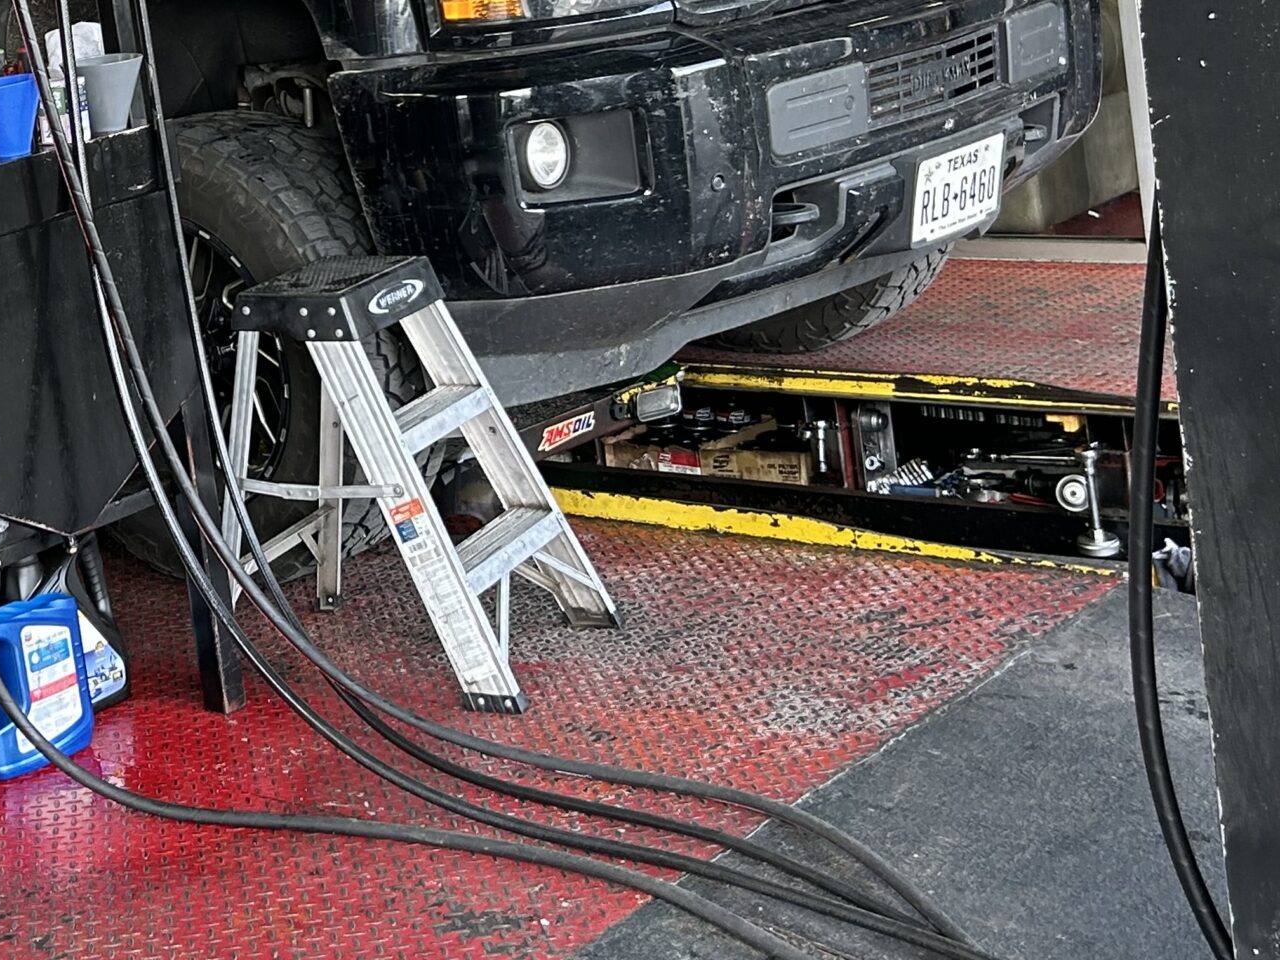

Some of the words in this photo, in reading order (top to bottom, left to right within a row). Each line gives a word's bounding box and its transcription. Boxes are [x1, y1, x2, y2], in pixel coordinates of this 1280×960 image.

[948, 149, 979, 173] TEXAS
[378, 284, 415, 308] WERNER
[542, 414, 593, 447] AMSOIL
